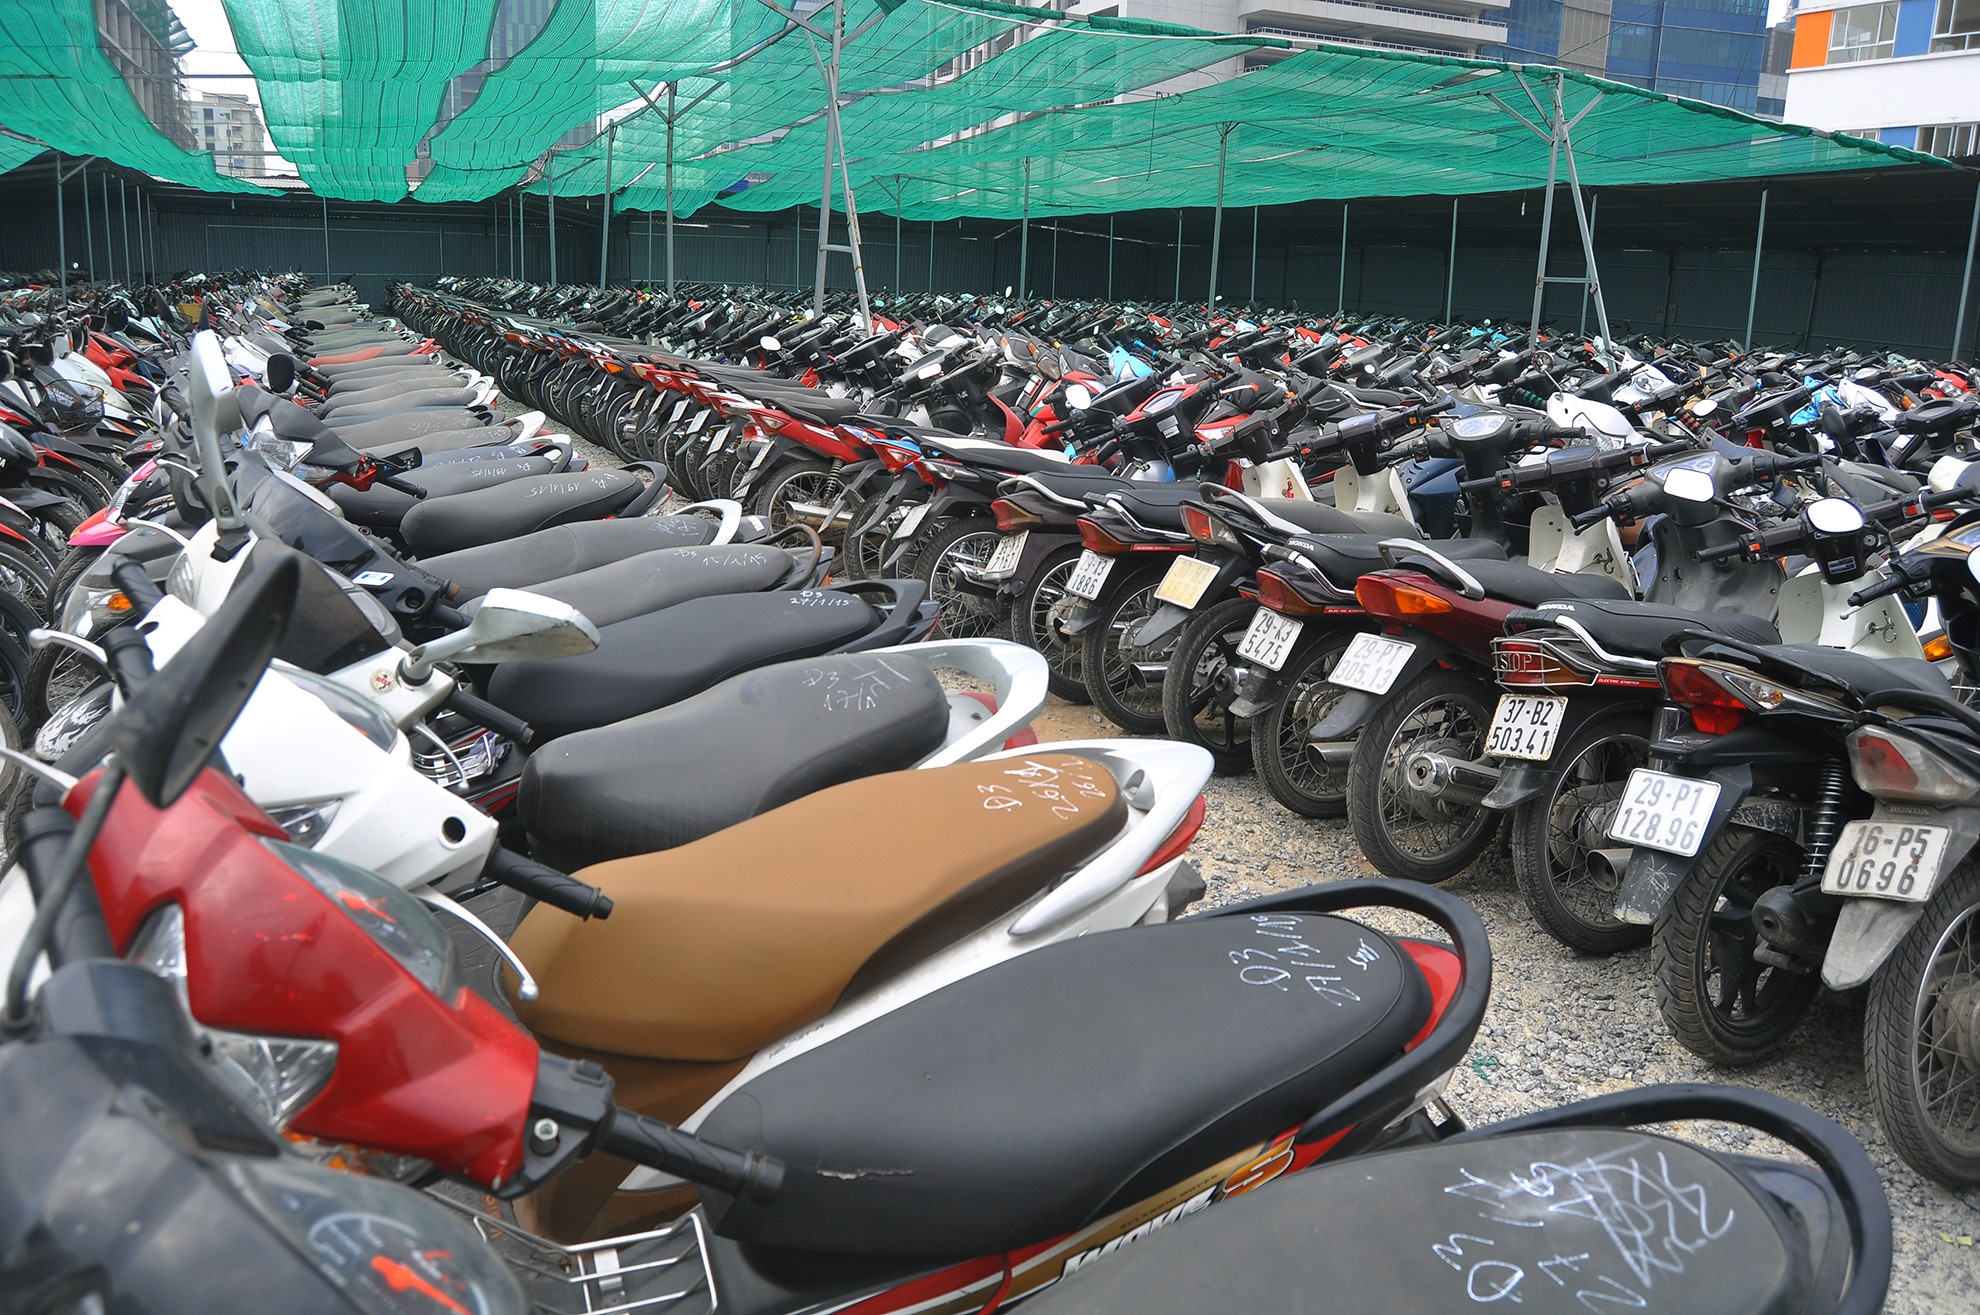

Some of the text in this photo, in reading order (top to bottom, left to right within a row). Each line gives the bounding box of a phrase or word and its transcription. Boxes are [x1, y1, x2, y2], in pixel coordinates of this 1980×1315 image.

[1288, 540, 1314, 551] HONDA
[1071, 573, 1098, 595] 1886
[1537, 604, 1575, 612] HONDA
[1254, 612, 1296, 643] 29-K3
[1244, 634, 1283, 665] 5475
[1353, 639, 1403, 665] 29-P1
[1335, 659, 1393, 689] 305.13
[1503, 699, 1554, 727] 37-B2
[1491, 726, 1550, 755] 503.41
[1634, 776, 1704, 815] 29-P1
[1889, 805, 1930, 815] HONDA
[1620, 807, 1698, 849] 128.96
[1852, 825, 1932, 860] 16-P5
[1836, 857, 1919, 895] 0696
